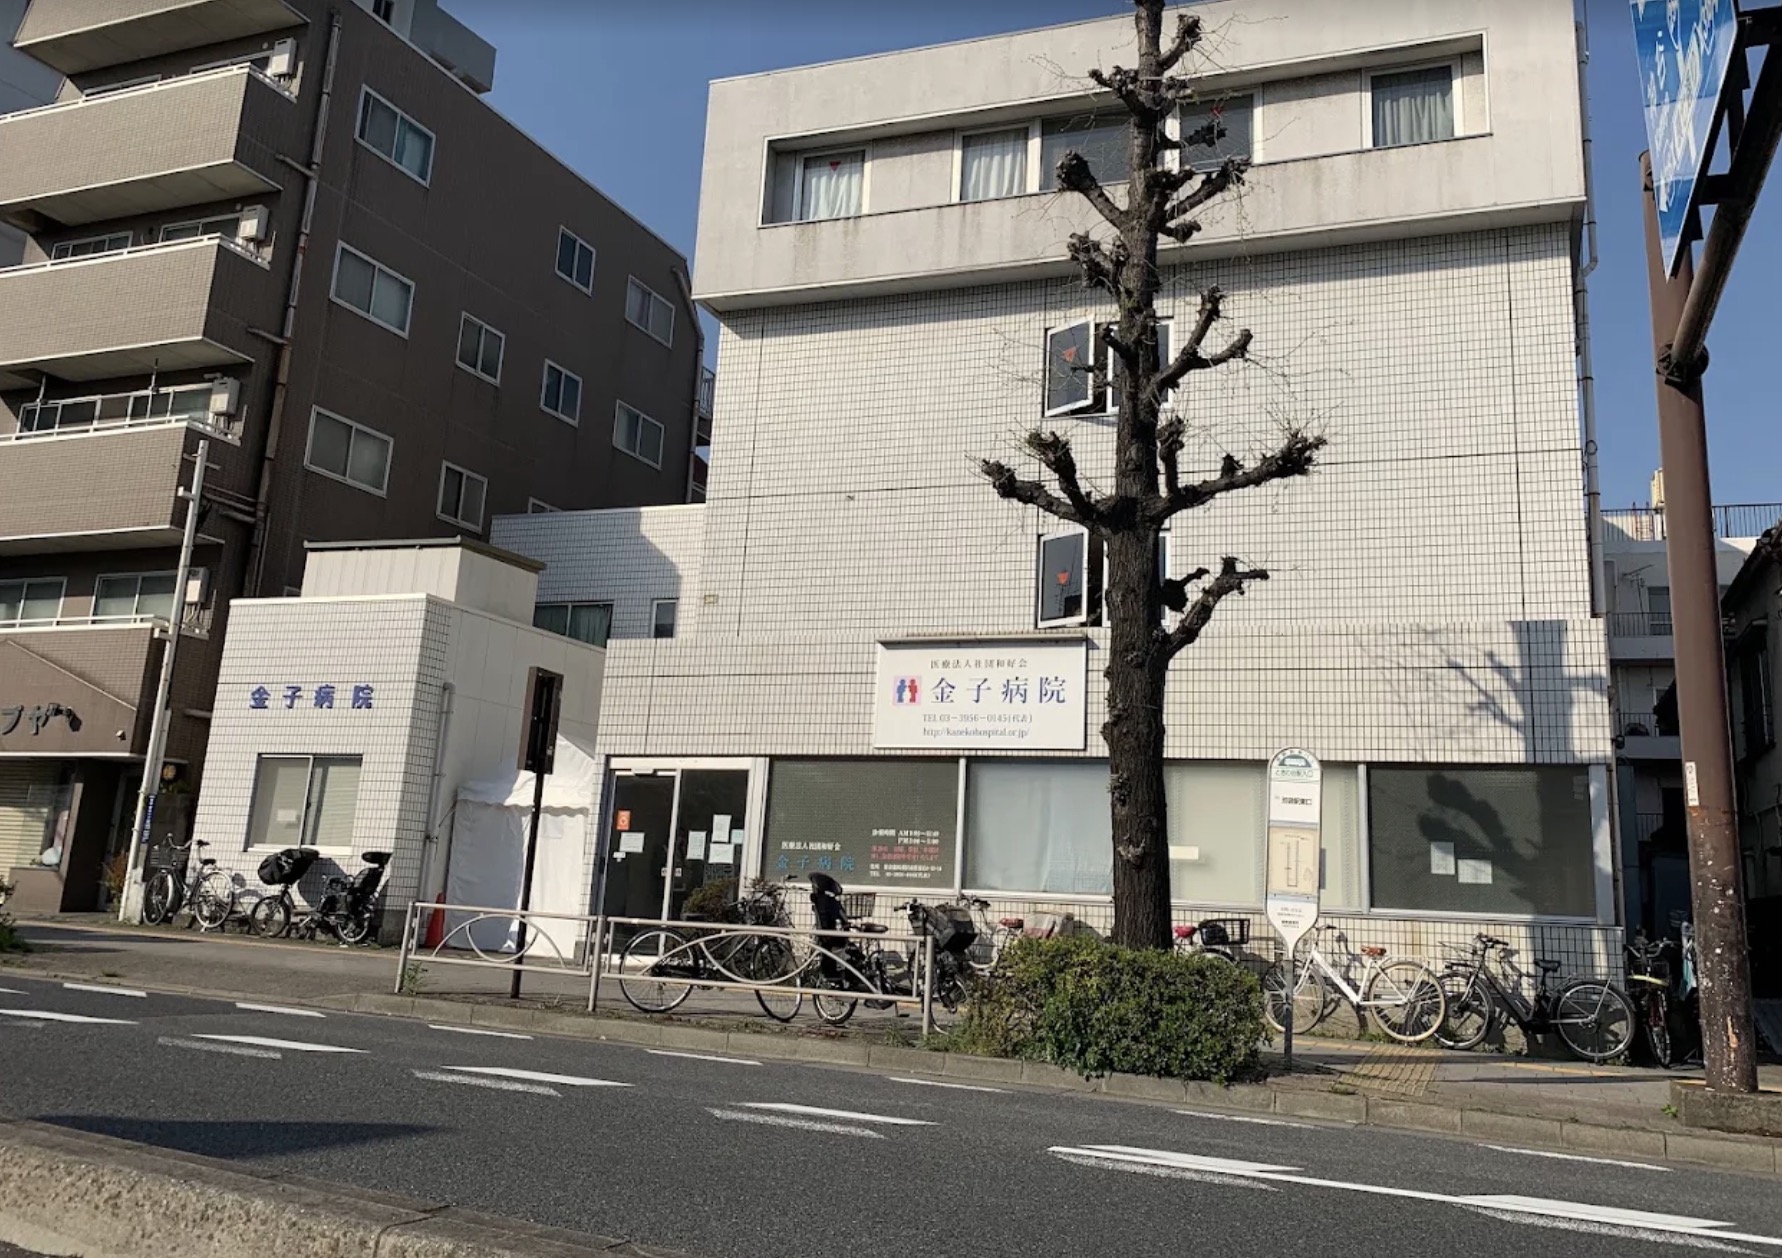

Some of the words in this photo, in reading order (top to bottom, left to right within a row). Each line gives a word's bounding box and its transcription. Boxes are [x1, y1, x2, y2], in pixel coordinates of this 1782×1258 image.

[930, 657, 1028, 670] 医療法人社団和好会
[248, 683, 375, 710] 金子病院
[930, 676, 1067, 704] 金子病院
[776, 854, 856, 871] 金子病院
